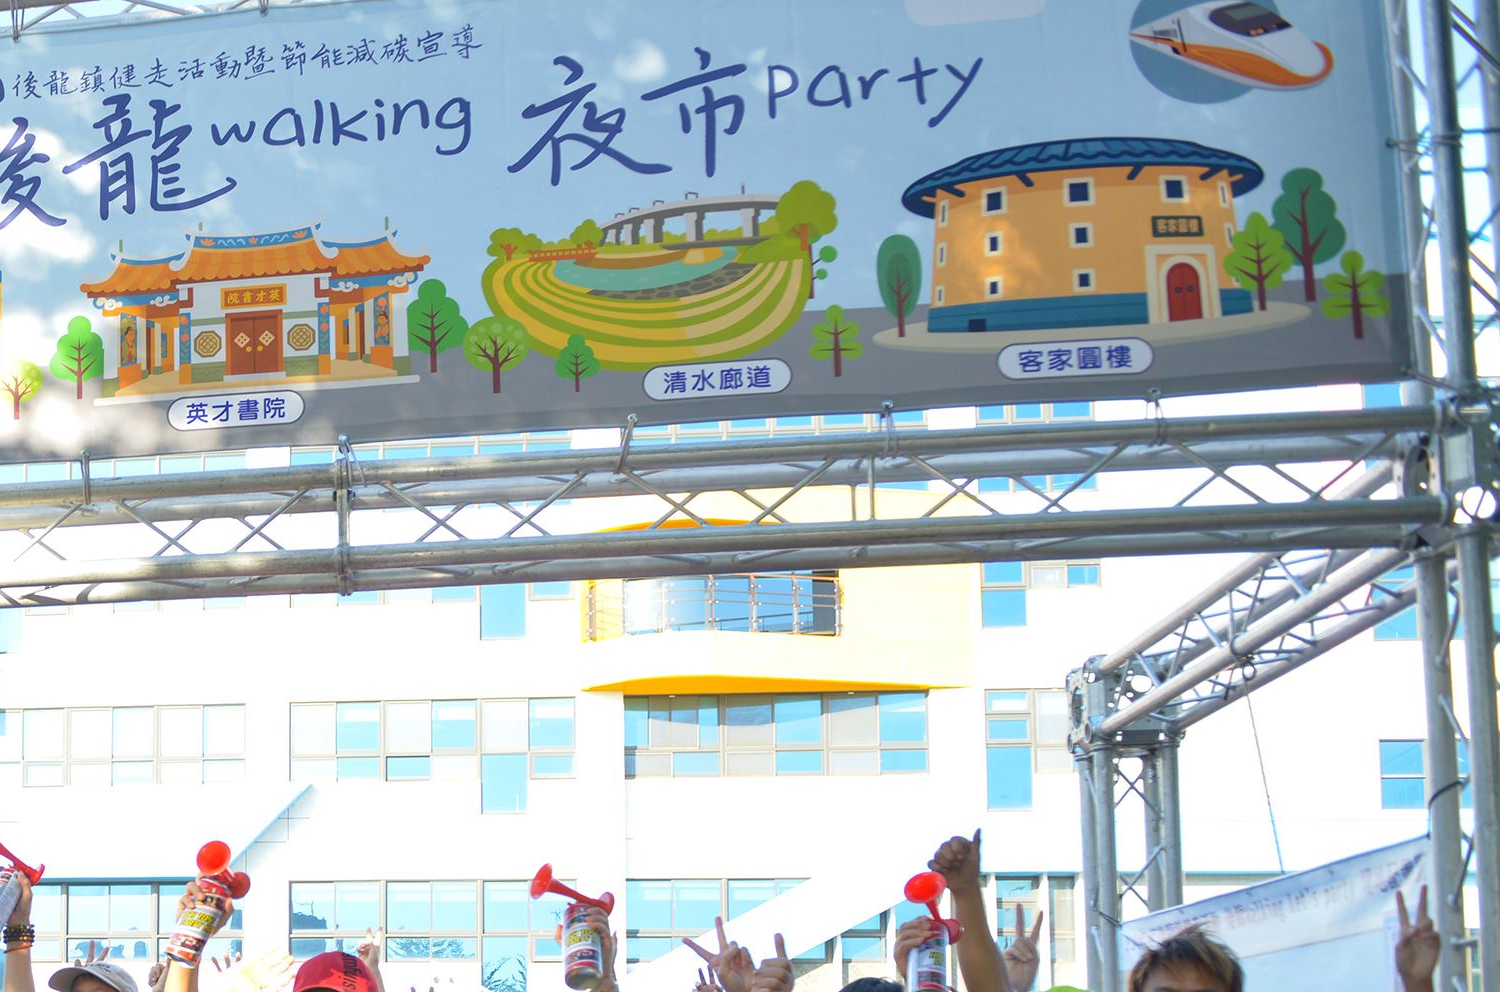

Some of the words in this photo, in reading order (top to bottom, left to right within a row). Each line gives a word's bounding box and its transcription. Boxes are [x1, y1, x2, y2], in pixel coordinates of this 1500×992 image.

[11, 23, 484, 101] 後龍鎮健走活動暨節能減碳宣導
[210, 97, 473, 156] walking
[506, 46, 748, 188] 夜市
[766, 56, 985, 128] party
[1017, 344, 1133, 374] 客家圓樓
[662, 365, 773, 394] 清水廊道
[185, 397, 286, 426] 英才書院
